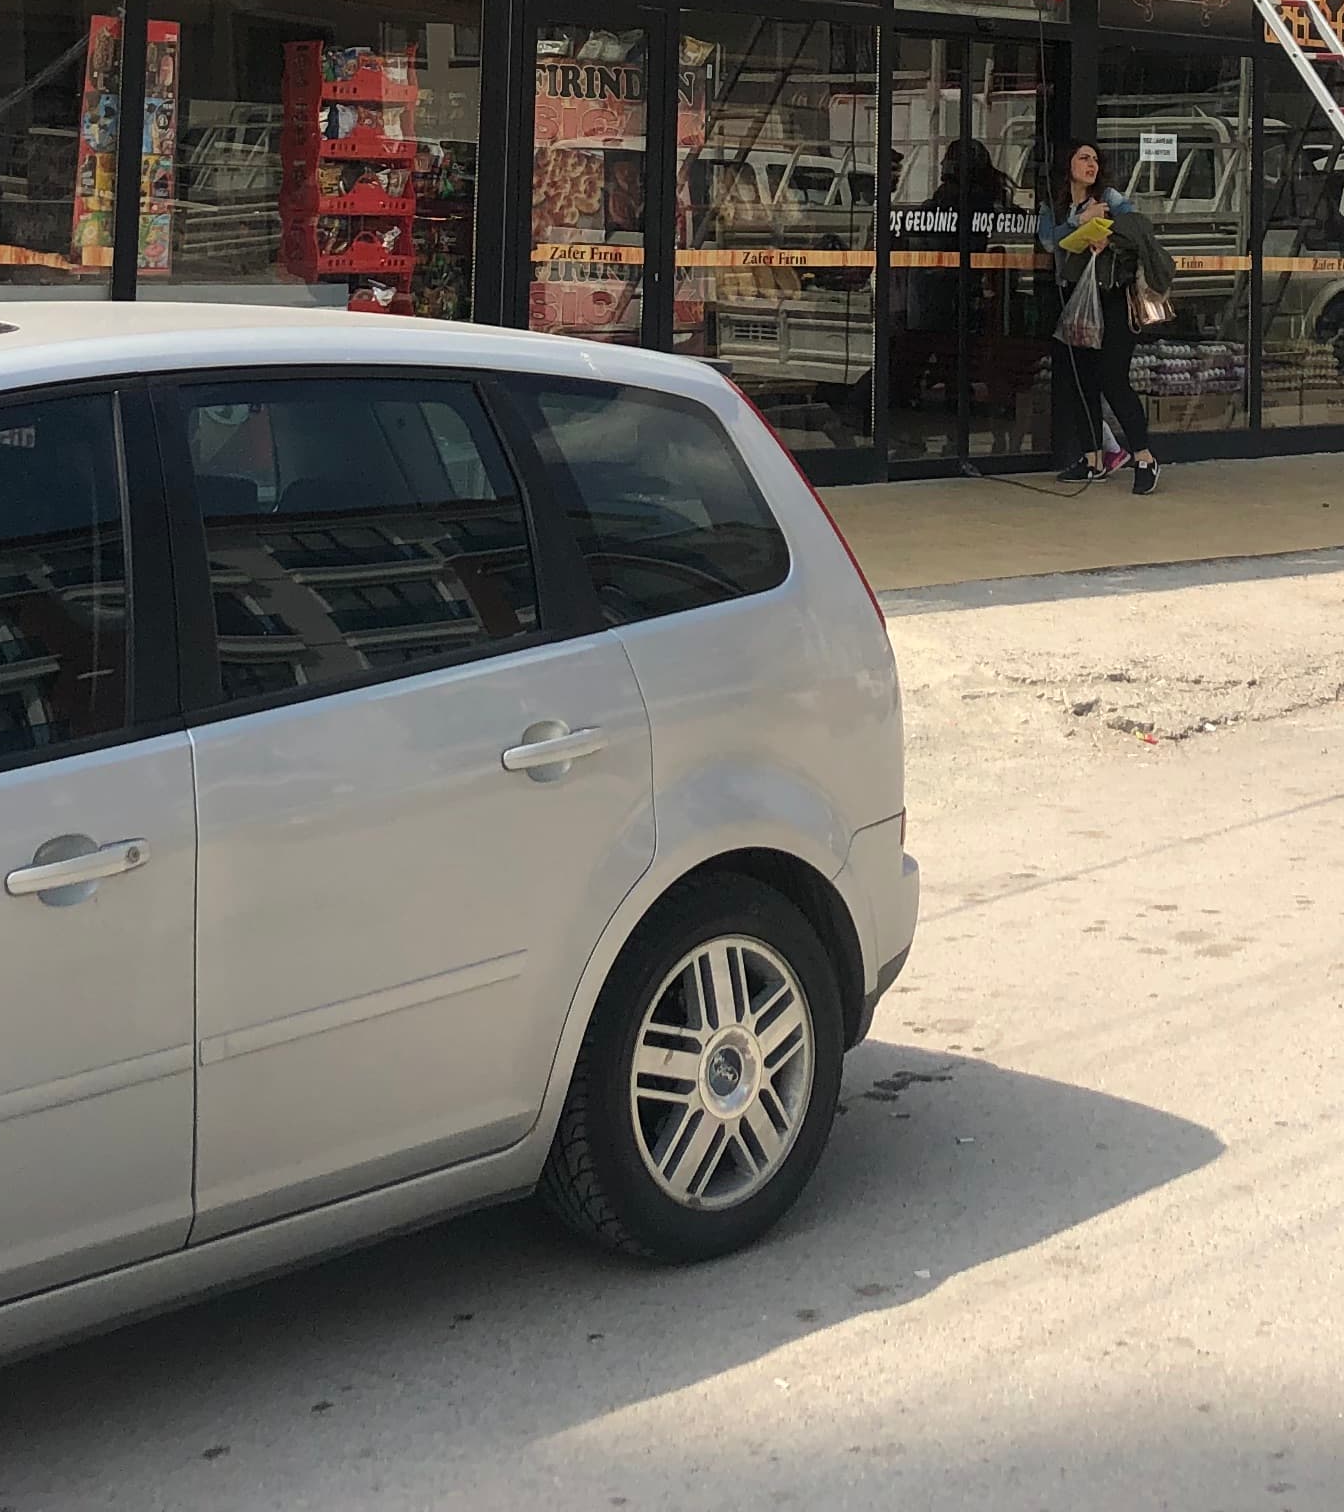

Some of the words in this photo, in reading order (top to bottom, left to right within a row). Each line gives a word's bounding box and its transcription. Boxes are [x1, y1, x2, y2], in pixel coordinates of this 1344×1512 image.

[906, 207, 958, 233] GELDİNİZ
[972, 212, 994, 238] HOŞ
[549, 247, 586, 261] Zafer
[590, 248, 622, 263] Fırın
[742, 252, 774, 266] Zafer
